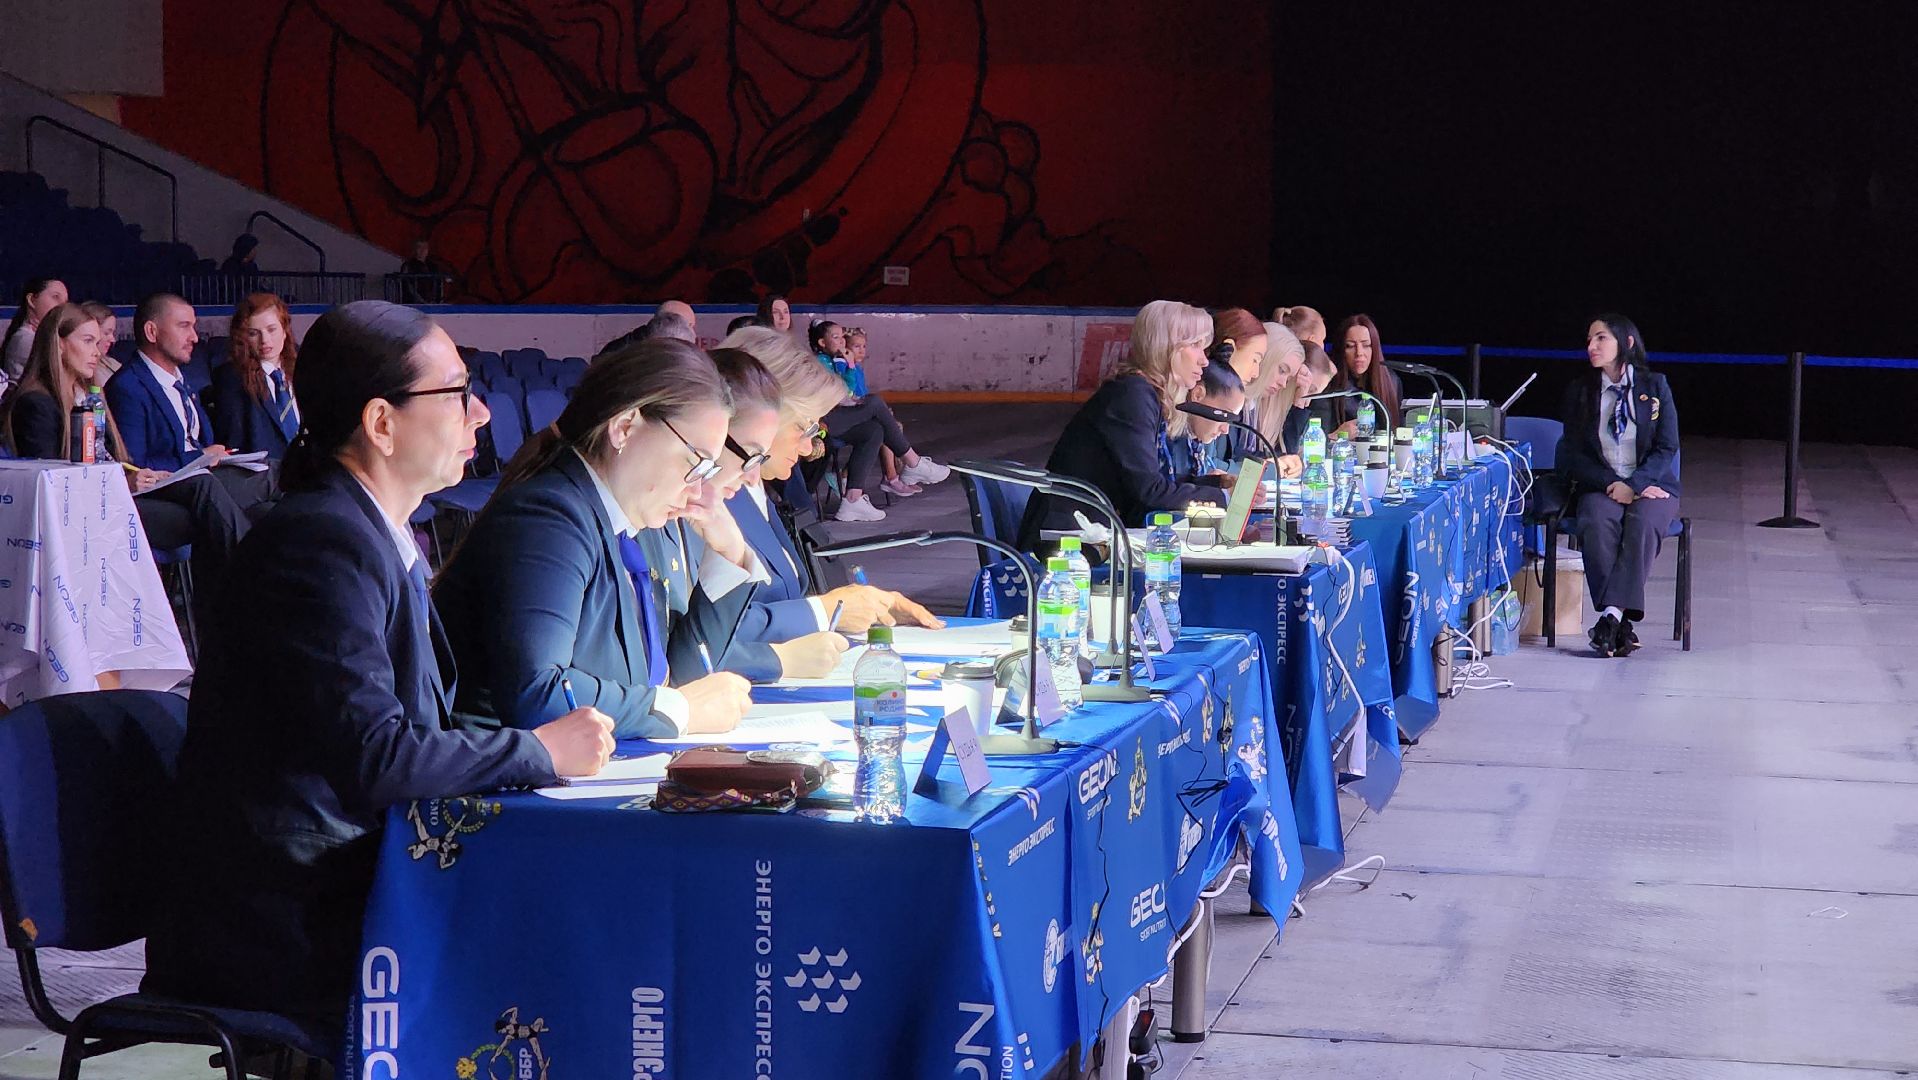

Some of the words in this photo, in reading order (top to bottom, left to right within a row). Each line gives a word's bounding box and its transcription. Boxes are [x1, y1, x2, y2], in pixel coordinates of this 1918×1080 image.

[127, 513, 139, 562] GEON
[52, 575, 79, 624] GEON
[981, 568, 993, 619] ЭКСПР
[132, 598, 142, 647] GEON
[1277, 594, 1287, 665] ЭКСПРЕСС
[1079, 749, 1118, 804] GEON
[756, 860, 772, 955] ЭНЕРГО
[519, 1047, 533, 1080] ББР
